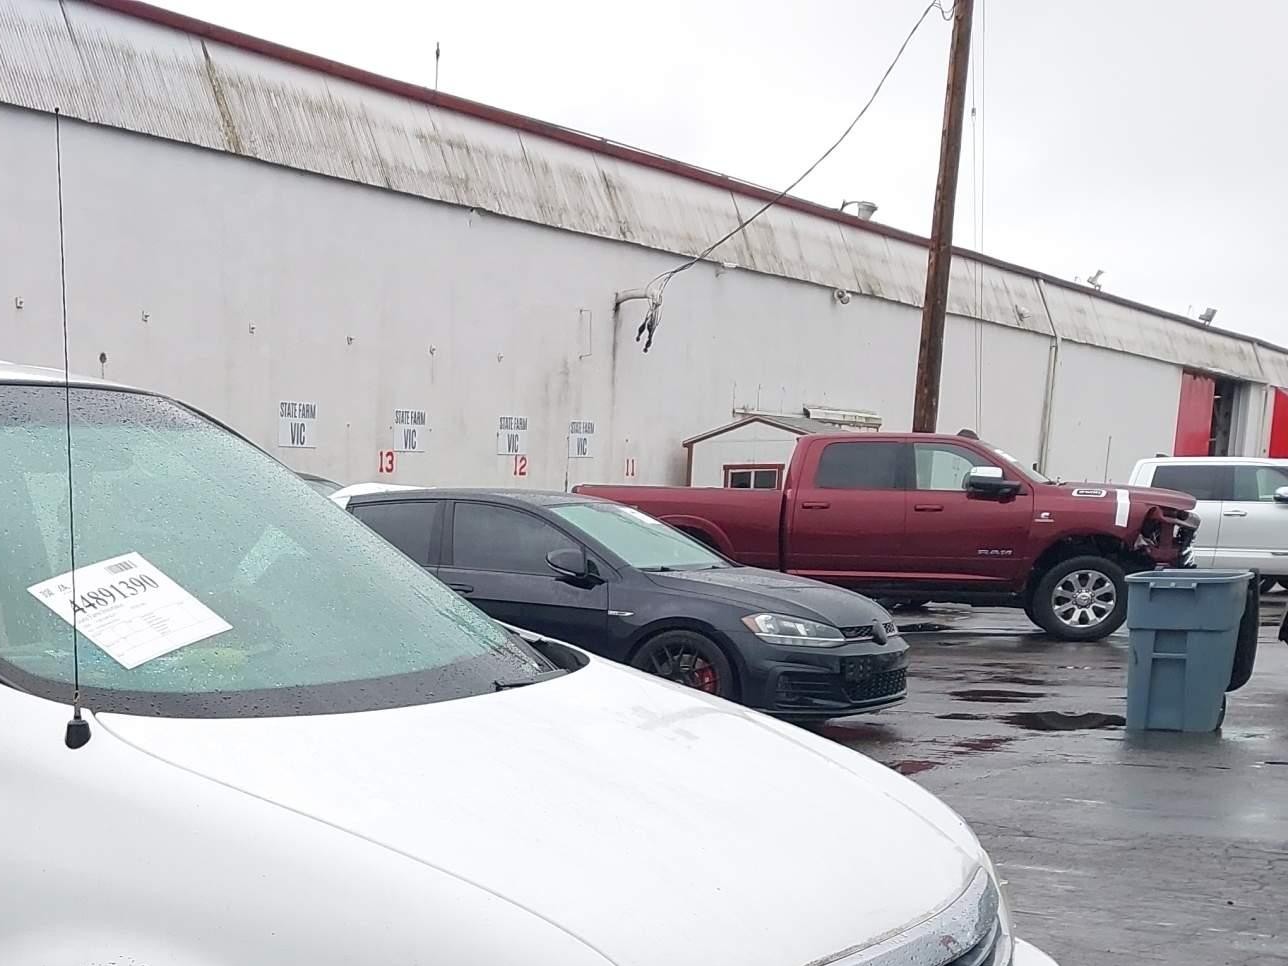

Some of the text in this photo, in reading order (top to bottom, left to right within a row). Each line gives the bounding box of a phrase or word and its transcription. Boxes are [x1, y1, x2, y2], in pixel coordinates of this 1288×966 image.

[280, 402, 316, 419] STATE FARM
[395, 410, 425, 426] STATE FARM
[290, 422, 305, 445] VIC
[500, 417, 527, 431] STATE FARM
[404, 428, 417, 450] VIC
[507, 434, 519, 453] VIC
[577, 437, 587, 456] VIC
[379, 451, 394, 473] 13
[514, 455, 527, 476] 12
[626, 458, 635, 476] 11
[69, 573, 159, 615] 44891390
